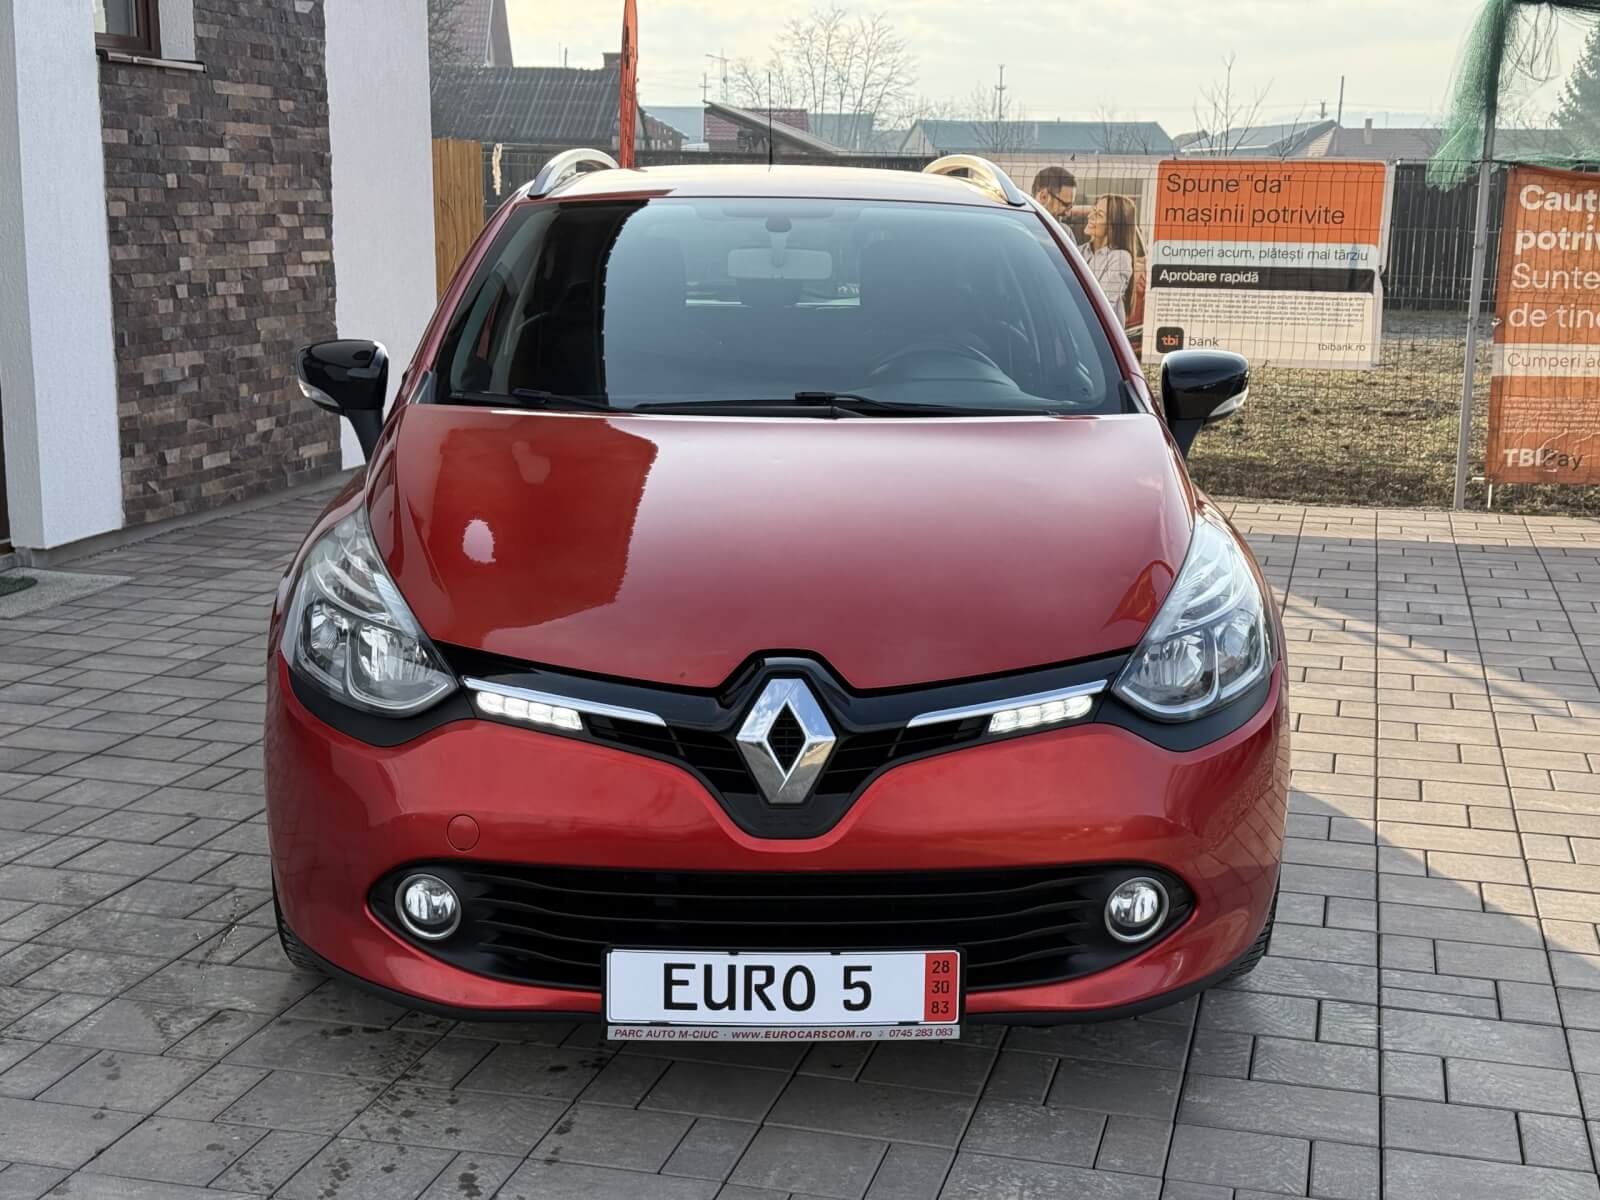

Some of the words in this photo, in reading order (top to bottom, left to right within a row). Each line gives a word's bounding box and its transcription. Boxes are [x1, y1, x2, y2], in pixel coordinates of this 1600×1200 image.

[1166, 173, 1239, 196] Spune
[1246, 174, 1291, 193] "da"
[1520, 184, 1600, 222] Cauț
[1164, 203, 1245, 227] mașinii
[1252, 204, 1345, 228] potrivite
[1162, 246, 1214, 259] Cumperi
[1217, 248, 1254, 260] acum,
[1258, 248, 1304, 262] plătești
[1307, 249, 1330, 260] mai
[1160, 269, 1217, 283] Aprobare
[1220, 271, 1259, 285] rapidă
[1512, 262, 1600, 290] Sunte
[1509, 302, 1547, 328] de
[1162, 334, 1179, 346] tbi
[1188, 336, 1218, 347] bank
[1318, 343, 1366, 352] tbibank.ro
[1508, 352, 1580, 370] Cumperi
[1586, 357, 1600, 369] a
[931, 960, 950, 974] 28
[663, 962, 815, 1012] EURO
[843, 965, 872, 1011] 5
[930, 980, 950, 994] 30
[930, 1000, 949, 1015] 83
[614, 1029, 643, 1038] PARC
[646, 1030, 676, 1038] AUTO
[678, 1030, 720, 1040] M-CIUC
[731, 1030, 872, 1040] www.EUROCARSCOM.ro
[888, 1029, 912, 1038] 0745
[914, 1028, 933, 1038] 283
[935, 1028, 954, 1037] 083
